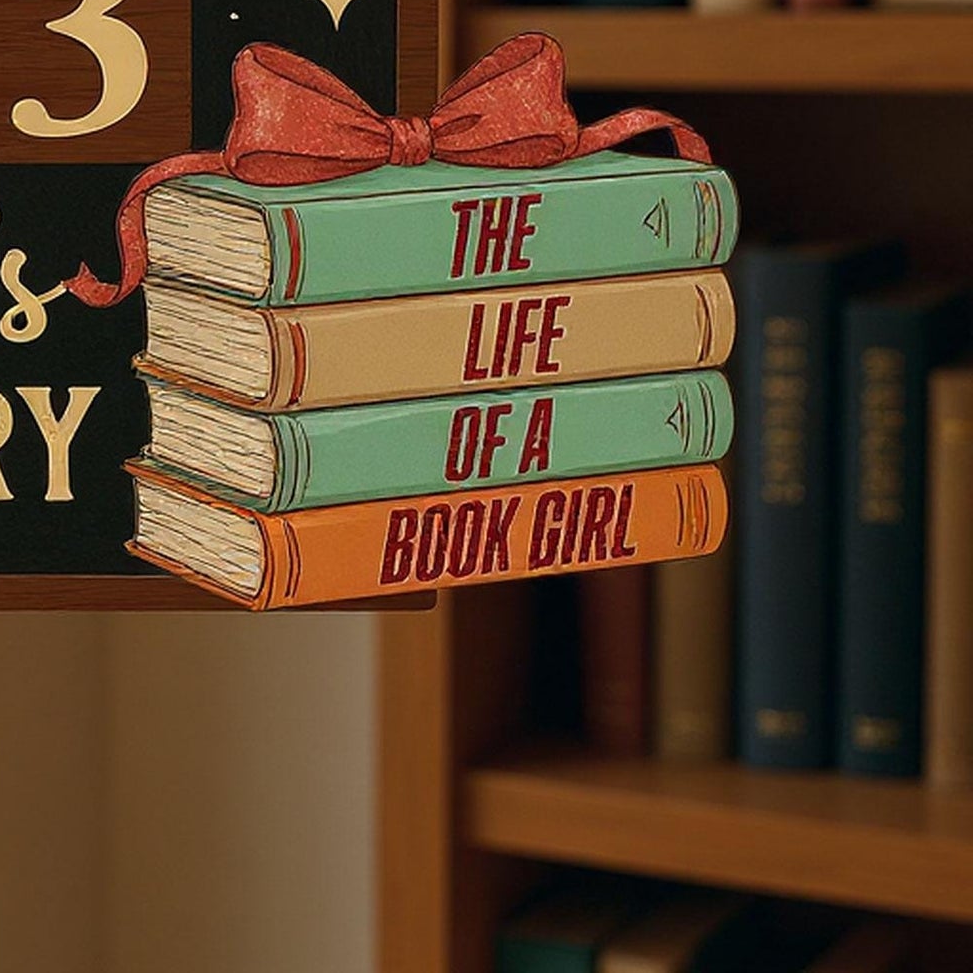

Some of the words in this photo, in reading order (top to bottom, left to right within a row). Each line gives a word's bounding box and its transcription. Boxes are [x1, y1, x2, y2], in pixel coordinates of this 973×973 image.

[451, 193, 542, 278] THE
[462, 295, 572, 381] LIFE
[444, 402, 513, 483] OF
[518, 397, 553, 474] A
[380, 494, 523, 585] BOOK
[529, 484, 637, 570] GIRL
